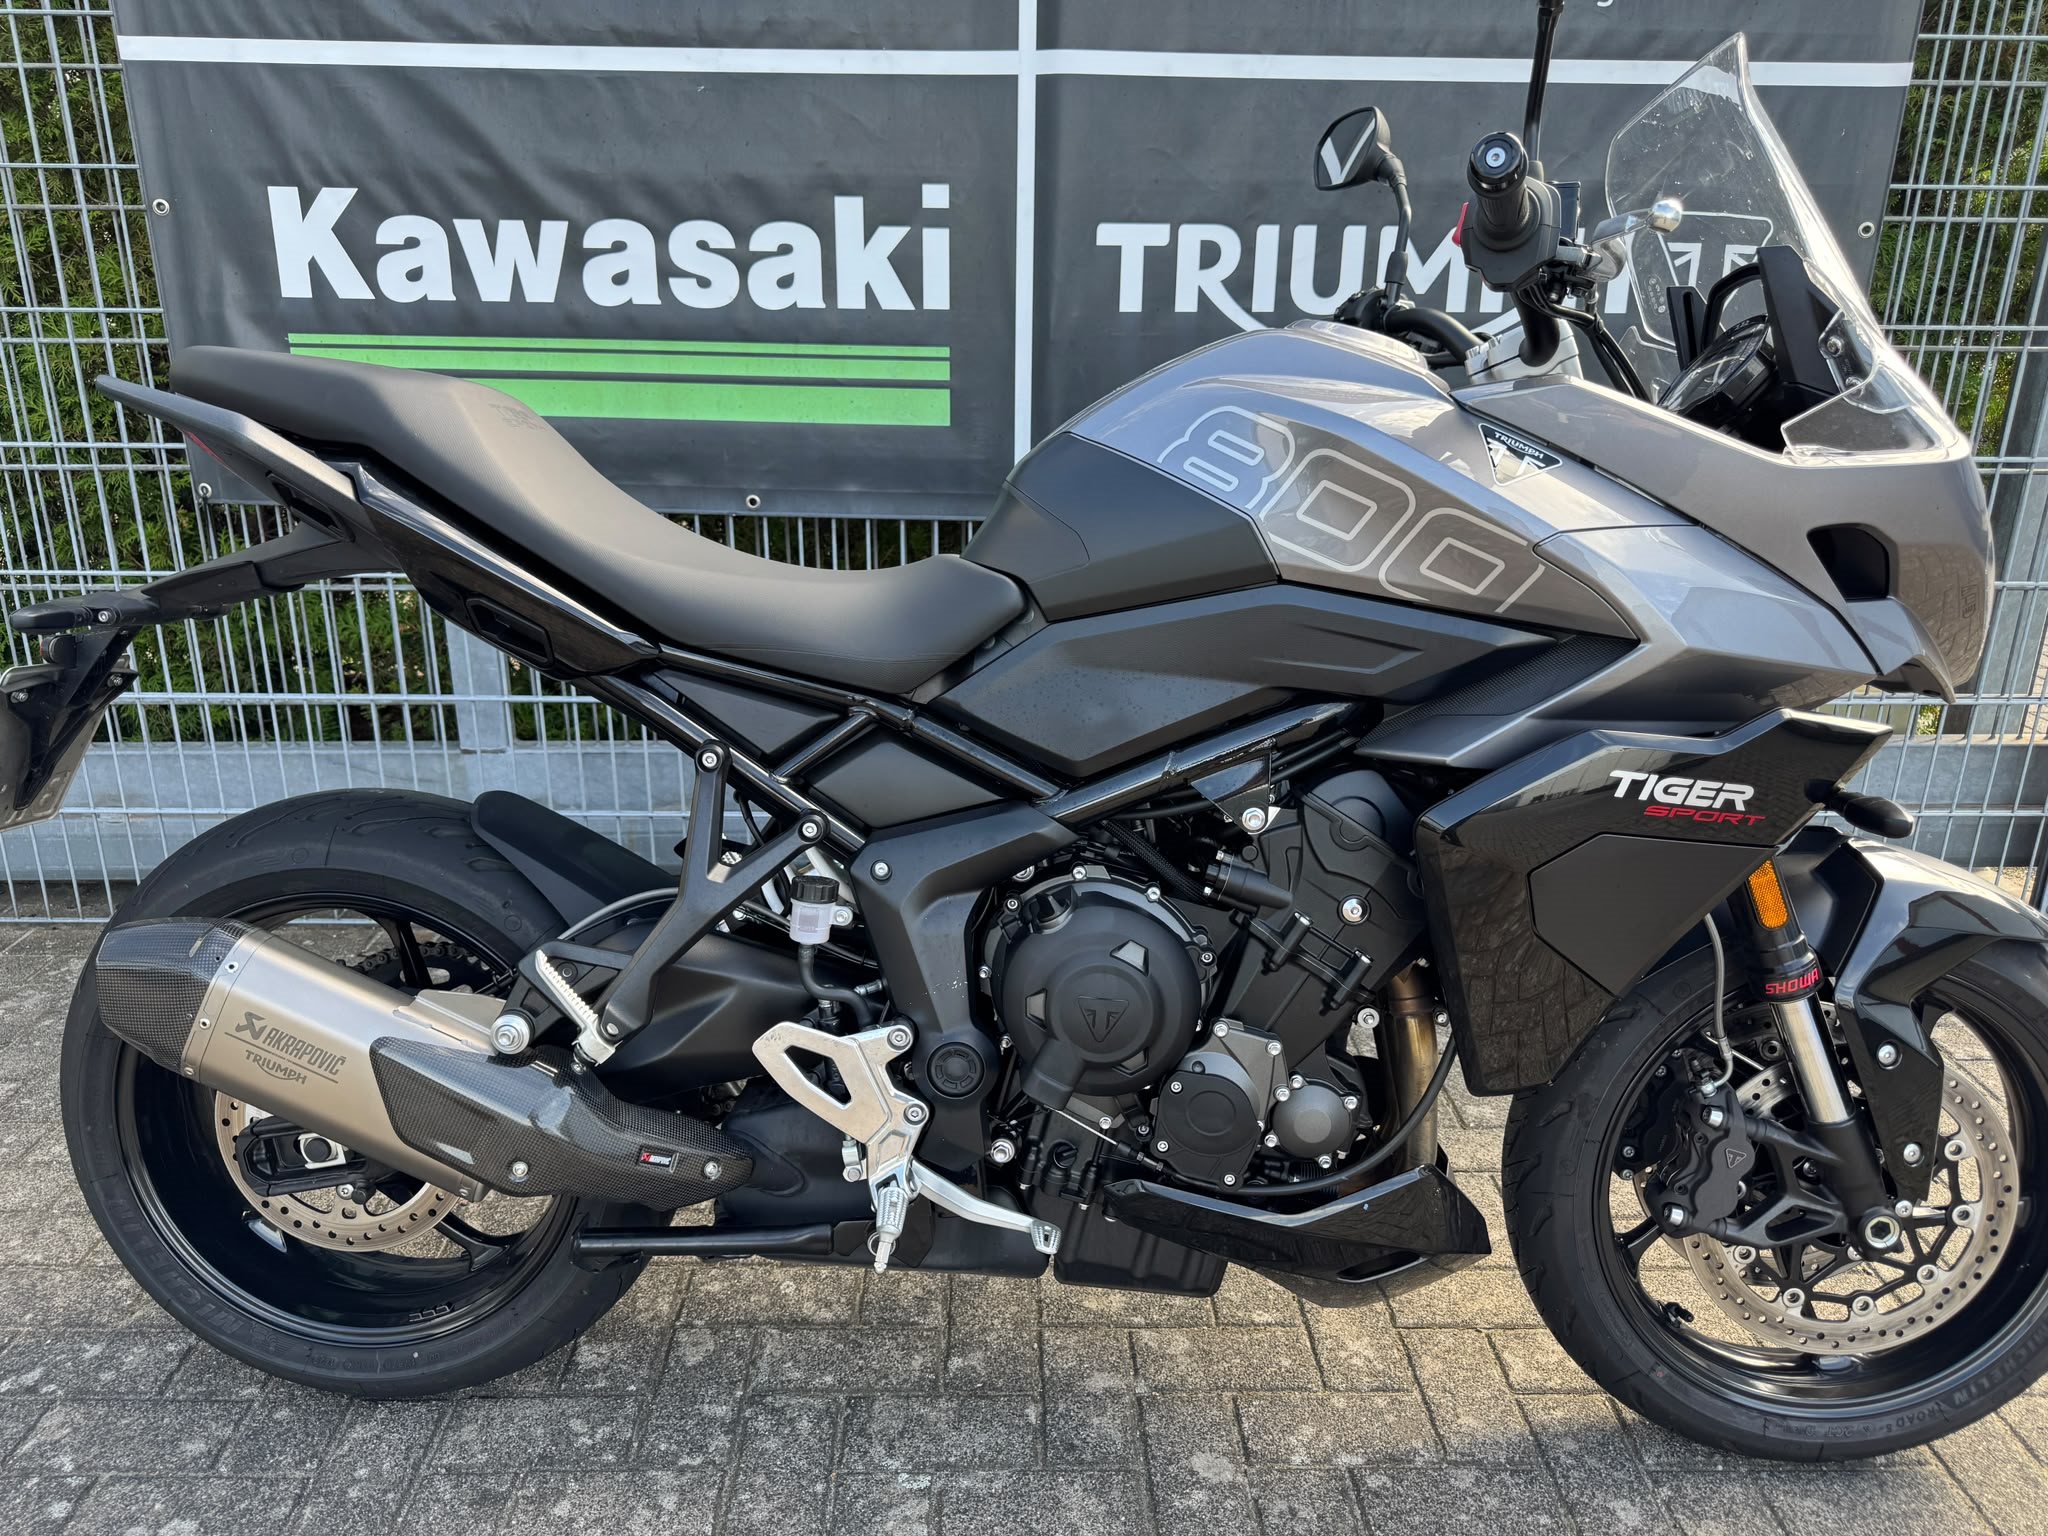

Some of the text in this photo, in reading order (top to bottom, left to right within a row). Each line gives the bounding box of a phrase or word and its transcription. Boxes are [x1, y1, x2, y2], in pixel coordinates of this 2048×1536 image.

[267, 183, 950, 311] Kawasaki
[1096, 222, 1635, 334] TRIUM
[1494, 431, 1544, 459] TRIUMPH
[1157, 405, 1546, 613] 800
[1609, 769, 1755, 812] TIGER
[1643, 805, 1766, 827] SPORT
[1765, 967, 1820, 996] SHOWA
[245, 1049, 308, 1085] TRIUMPH
